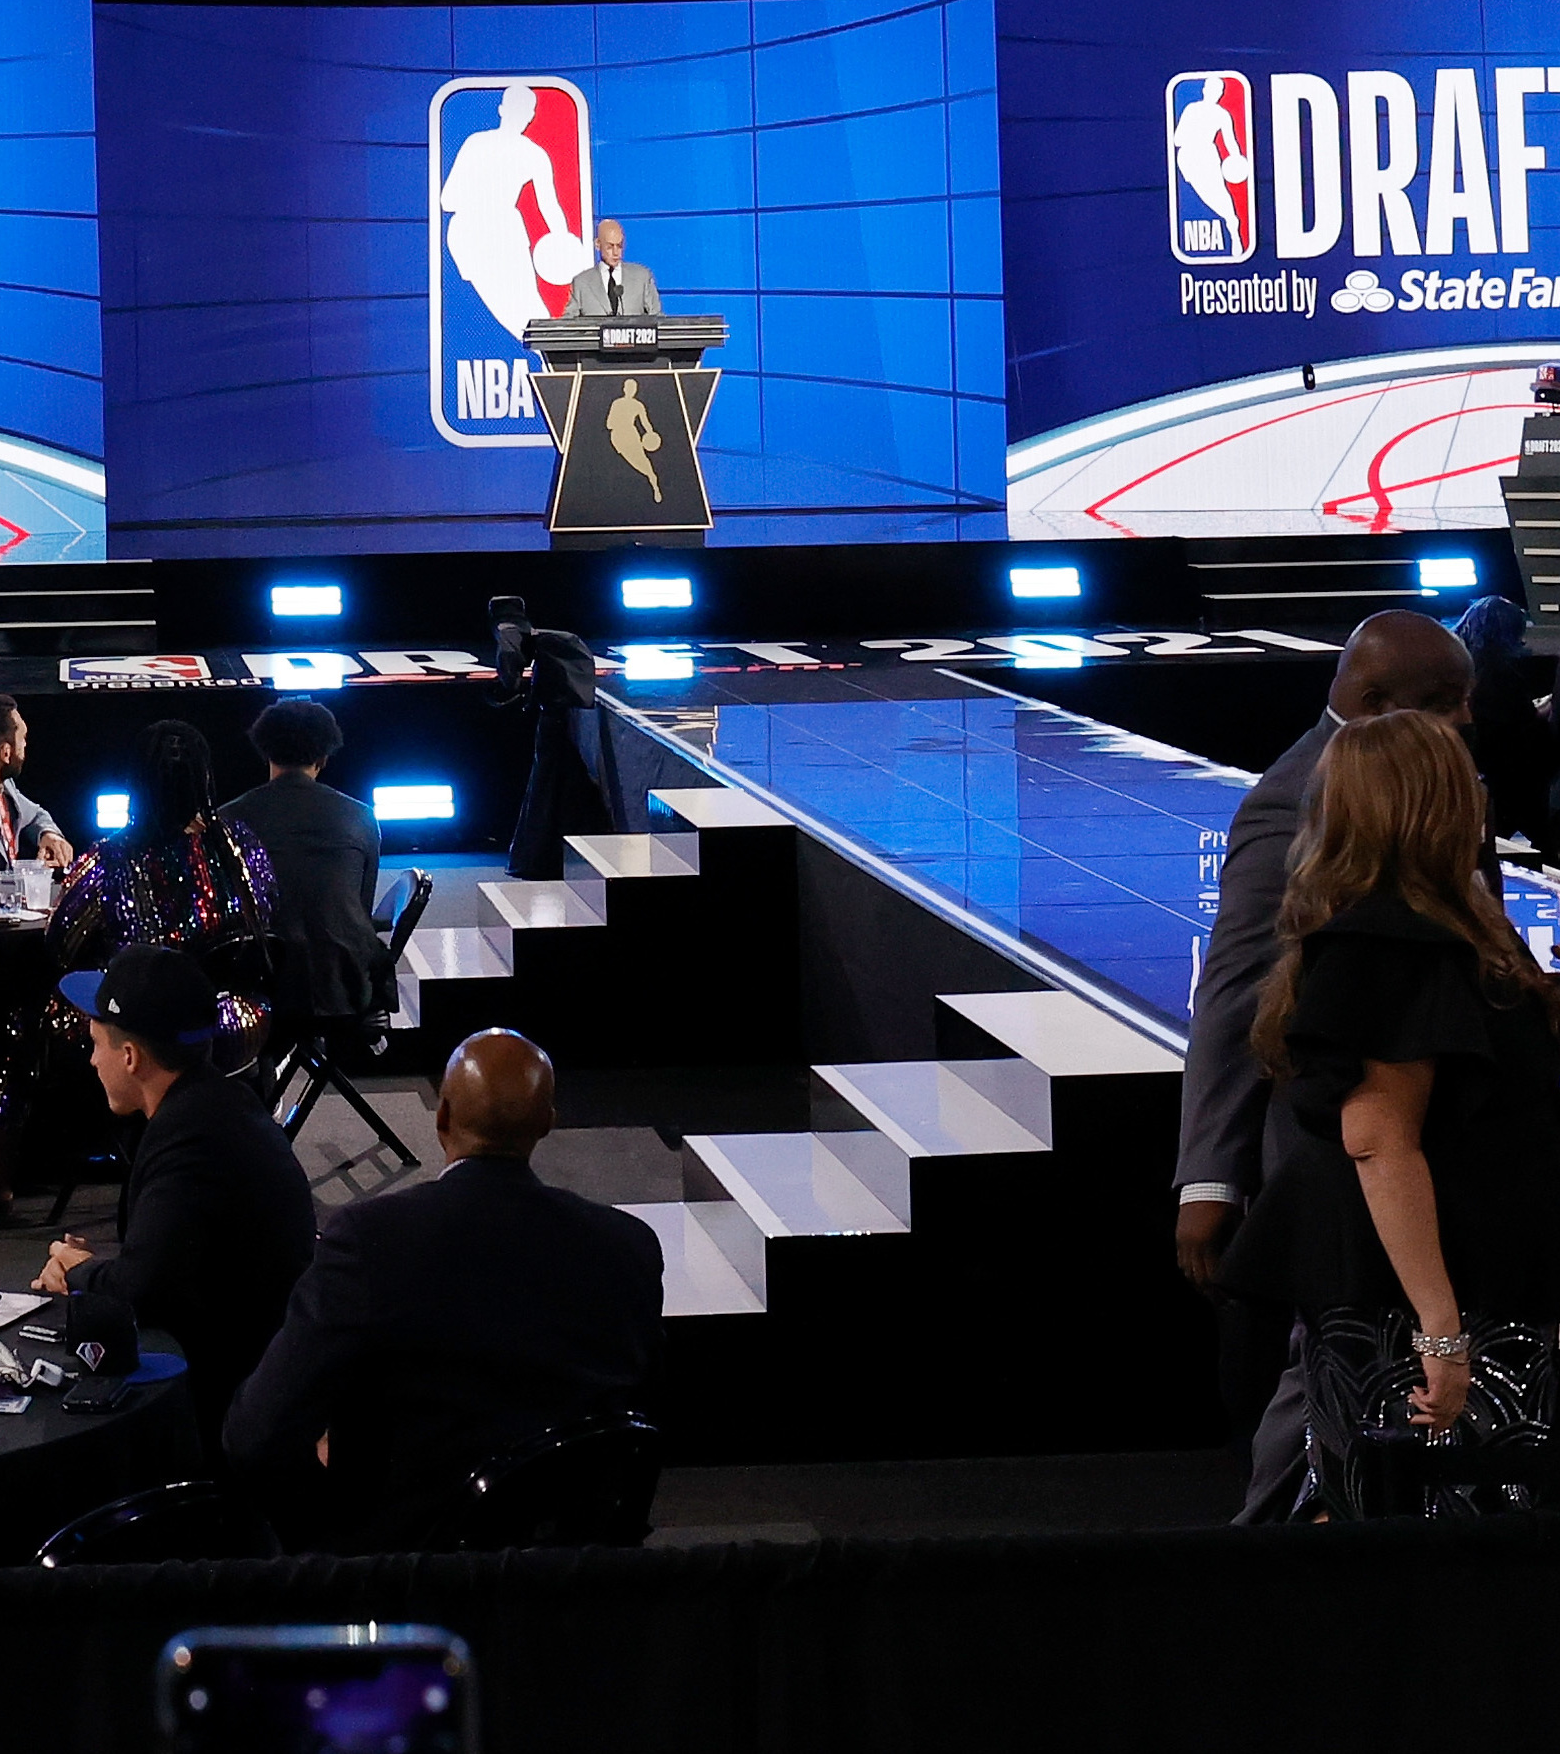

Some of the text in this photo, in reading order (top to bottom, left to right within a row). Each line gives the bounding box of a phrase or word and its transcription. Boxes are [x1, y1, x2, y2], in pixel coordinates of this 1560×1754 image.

[1184, 221, 1225, 252] NBA
[1181, 271, 1287, 314] Presented
[1292, 270, 1317, 319] by
[611, 328, 656, 344] DRAFT 2021
[458, 359, 536, 420] NBA
[859, 629, 1347, 661] 2021
